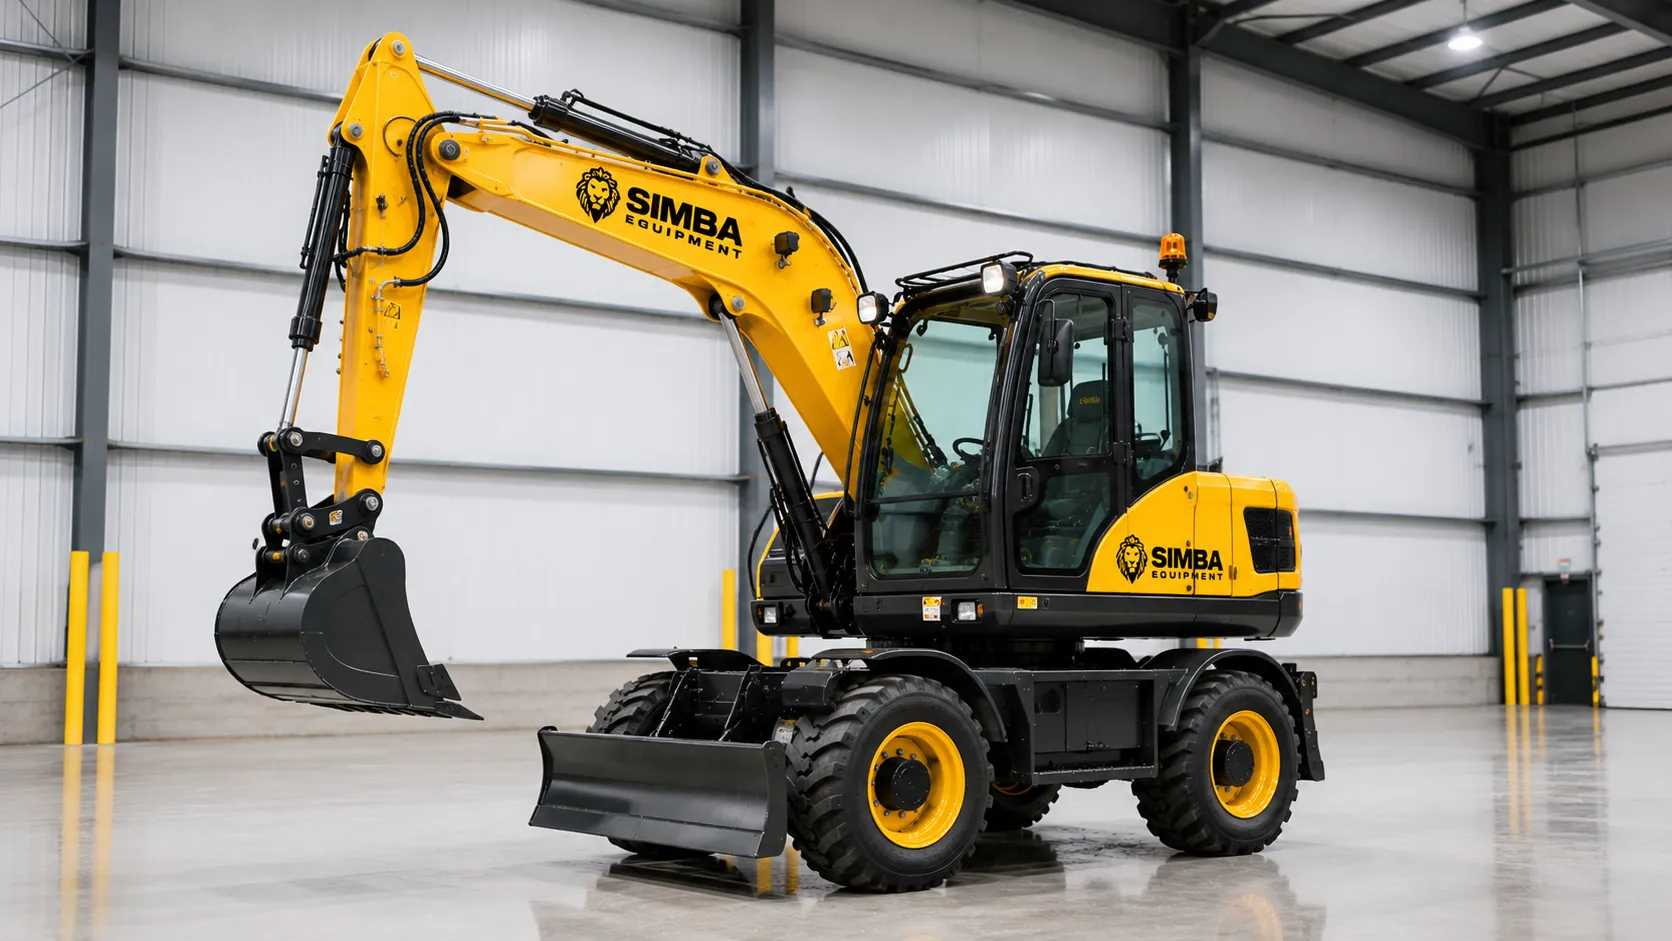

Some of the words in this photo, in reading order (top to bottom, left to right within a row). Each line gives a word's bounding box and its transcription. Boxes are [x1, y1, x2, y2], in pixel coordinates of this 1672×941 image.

[626, 187, 743, 246] SIMBA
[625, 214, 742, 259] EQUIPMENT
[1151, 546, 1223, 571] SIMBA
[1152, 571, 1223, 581] EQUIPMENT
